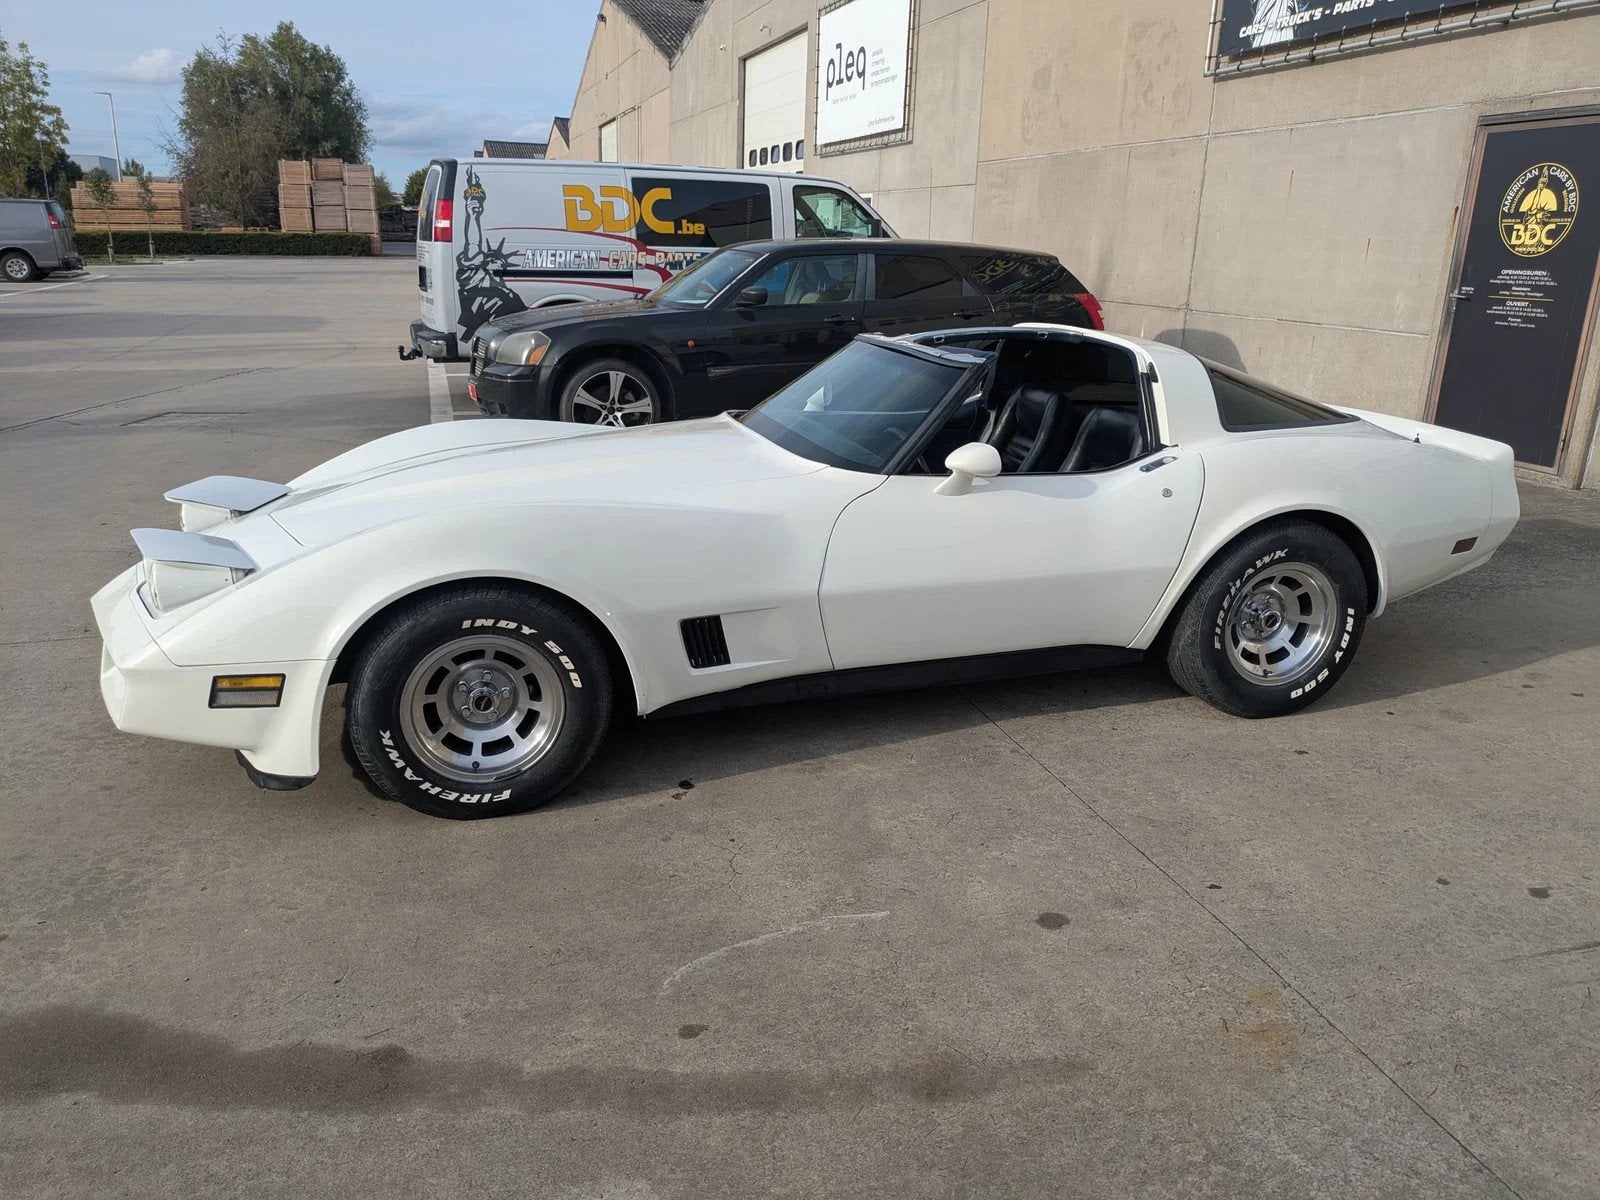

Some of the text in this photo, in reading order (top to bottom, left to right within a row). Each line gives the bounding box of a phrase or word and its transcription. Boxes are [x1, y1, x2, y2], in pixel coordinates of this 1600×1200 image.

[1239, 21, 1265, 38] CARS
[1276, 8, 1323, 30] TRUCK'S
[1333, 0, 1375, 15] PARTS
[825, 42, 866, 101] pleq
[1503, 166, 1577, 213] AMERICAN CARS BY BDC
[521, 249, 600, 270] AMERICAN
[608, 250, 648, 270] CARS
[1510, 223, 1557, 246] BDC
[1214, 548, 1289, 650] FIREHAWK
[461, 618, 583, 689] INDY 500
[1290, 607, 1355, 699] INDY 500
[379, 729, 512, 804] FIREHAWK
